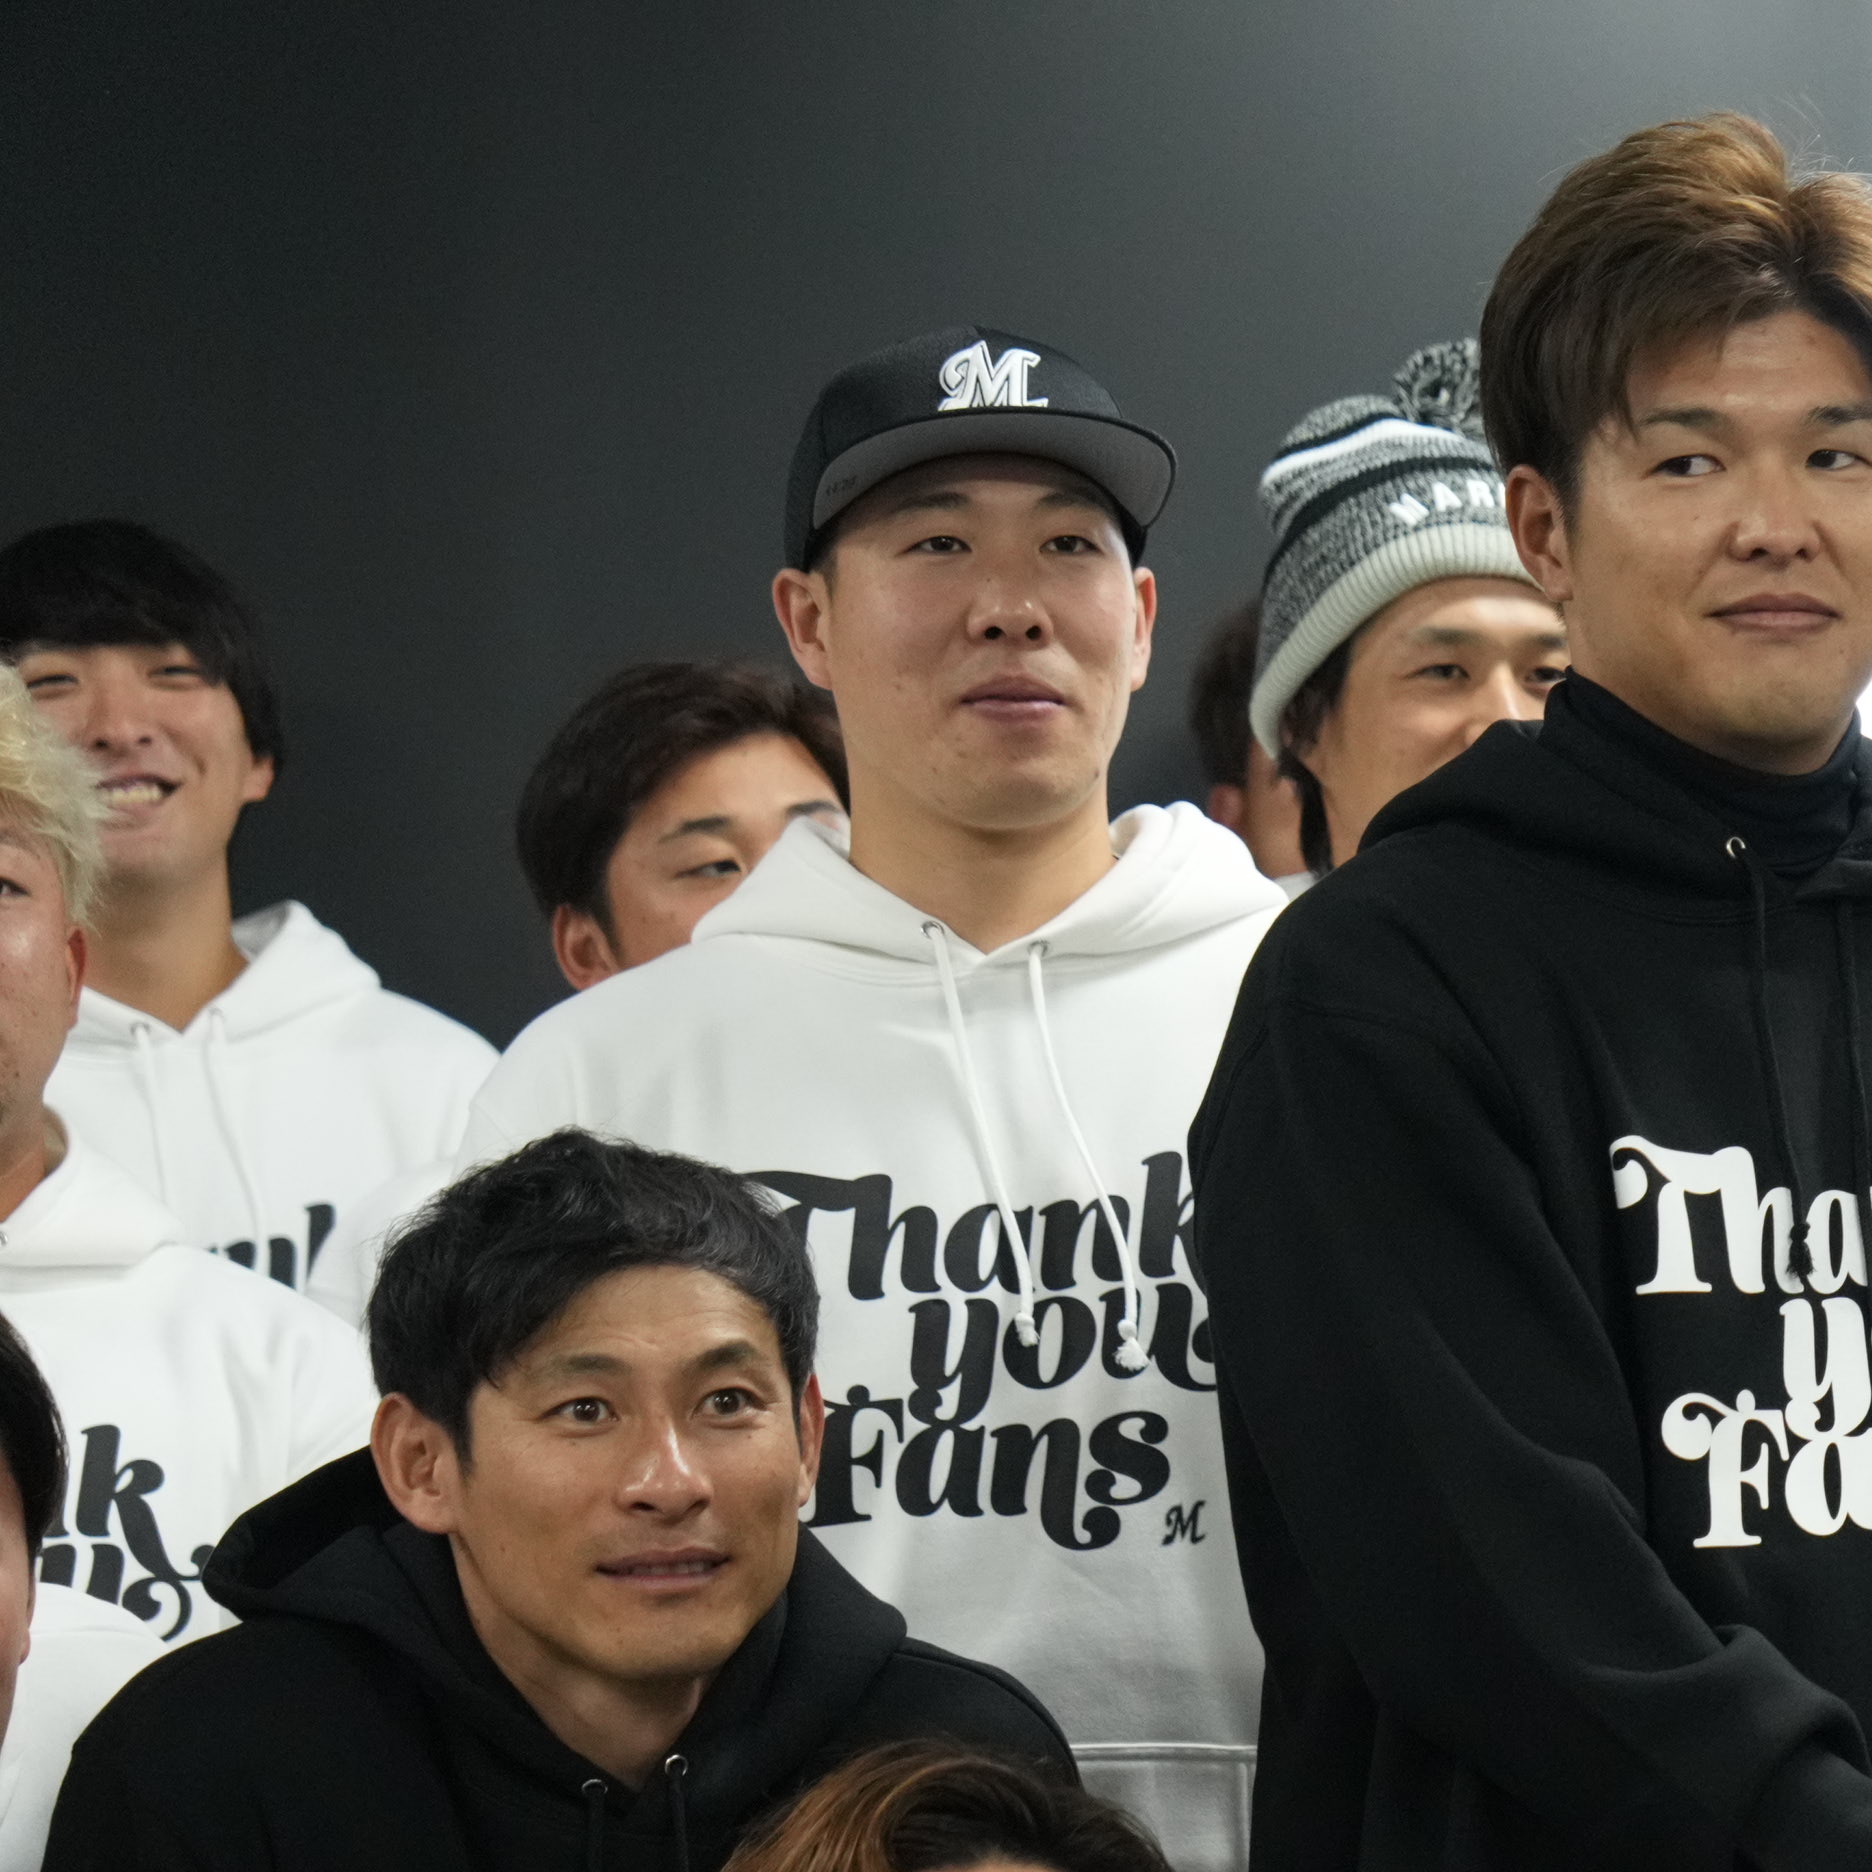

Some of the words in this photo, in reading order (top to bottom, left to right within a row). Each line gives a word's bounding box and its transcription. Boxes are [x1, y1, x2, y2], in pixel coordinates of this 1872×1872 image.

[938, 340, 1049, 412] M
[908, 1282, 1217, 1426] you
[805, 1385, 1171, 1551] Fans
